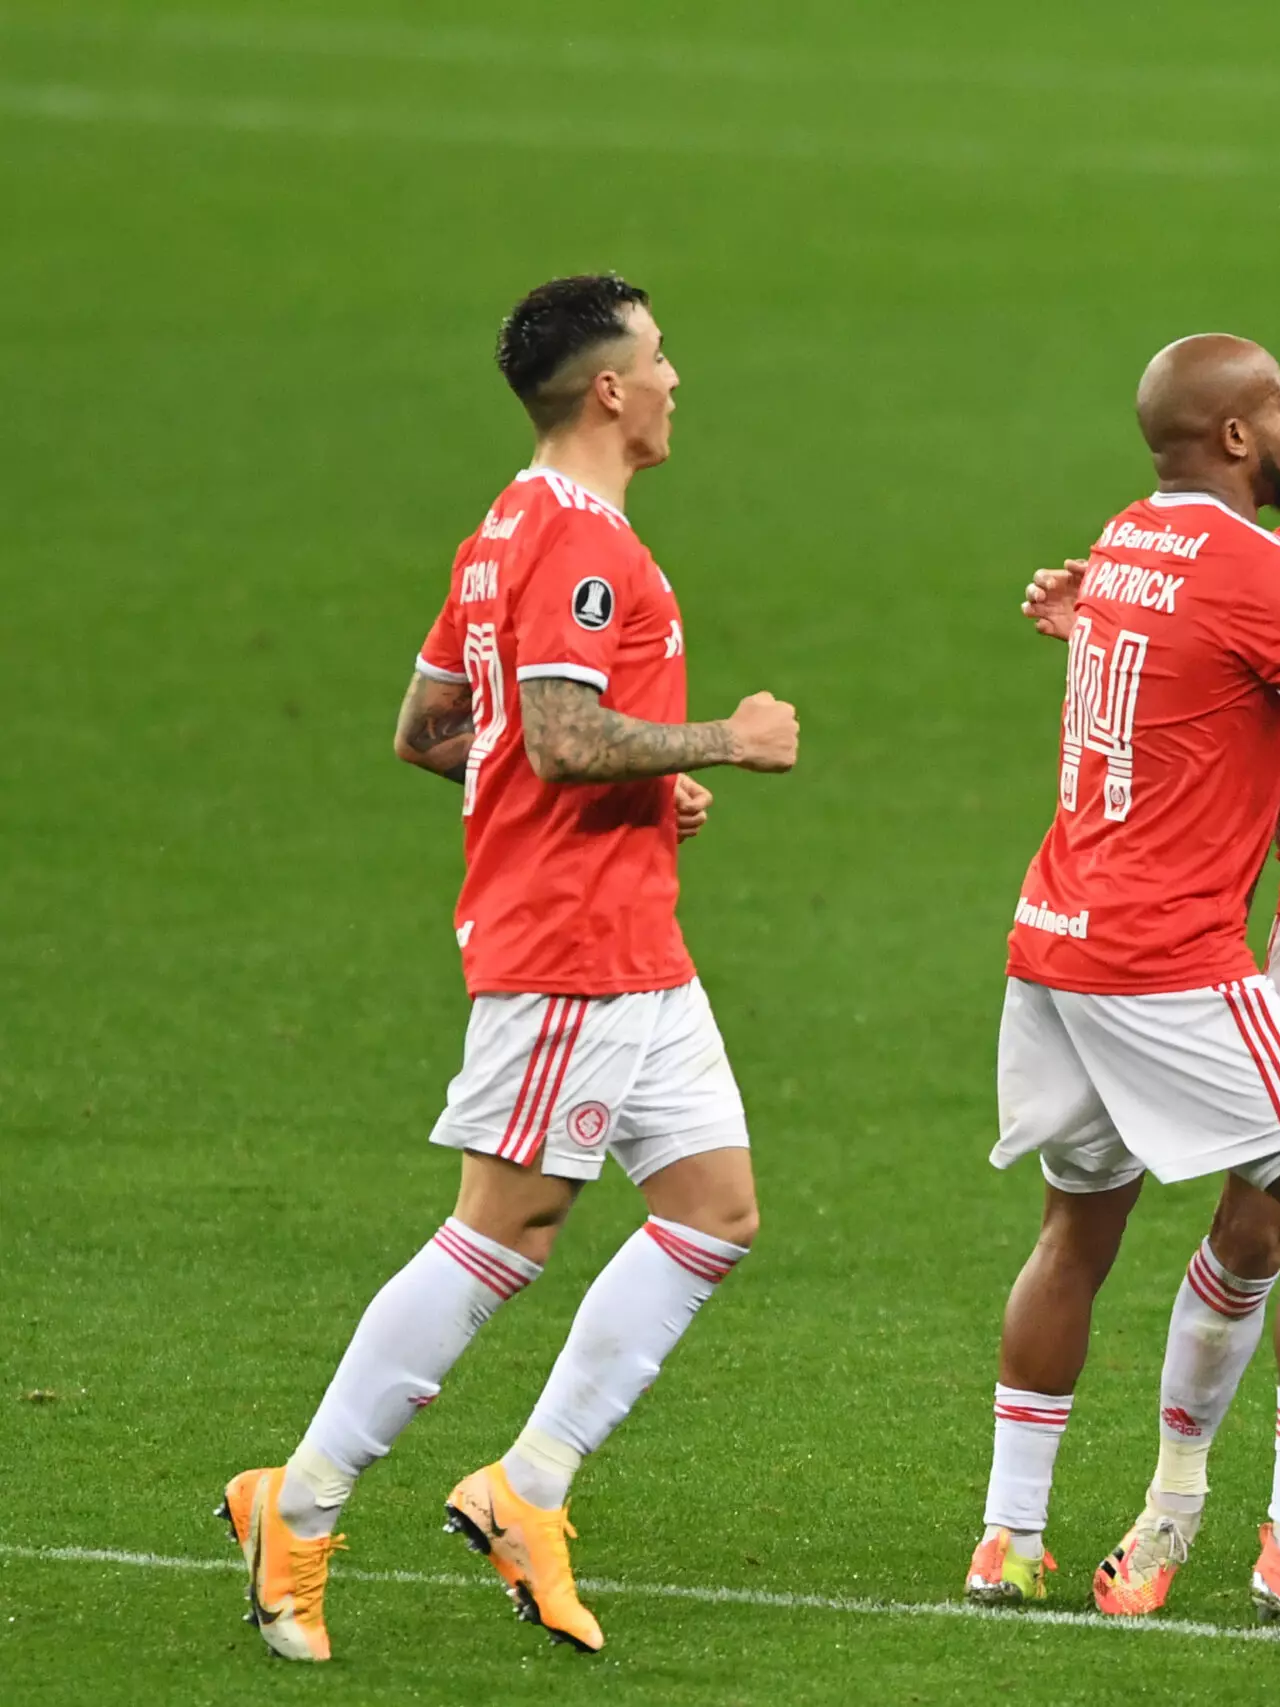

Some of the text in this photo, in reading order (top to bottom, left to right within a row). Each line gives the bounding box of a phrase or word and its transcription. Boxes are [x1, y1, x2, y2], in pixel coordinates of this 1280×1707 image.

[1110, 521, 1210, 560] Banrisul
[1089, 561, 1185, 614] PATRICK
[1060, 615, 1150, 822] 14
